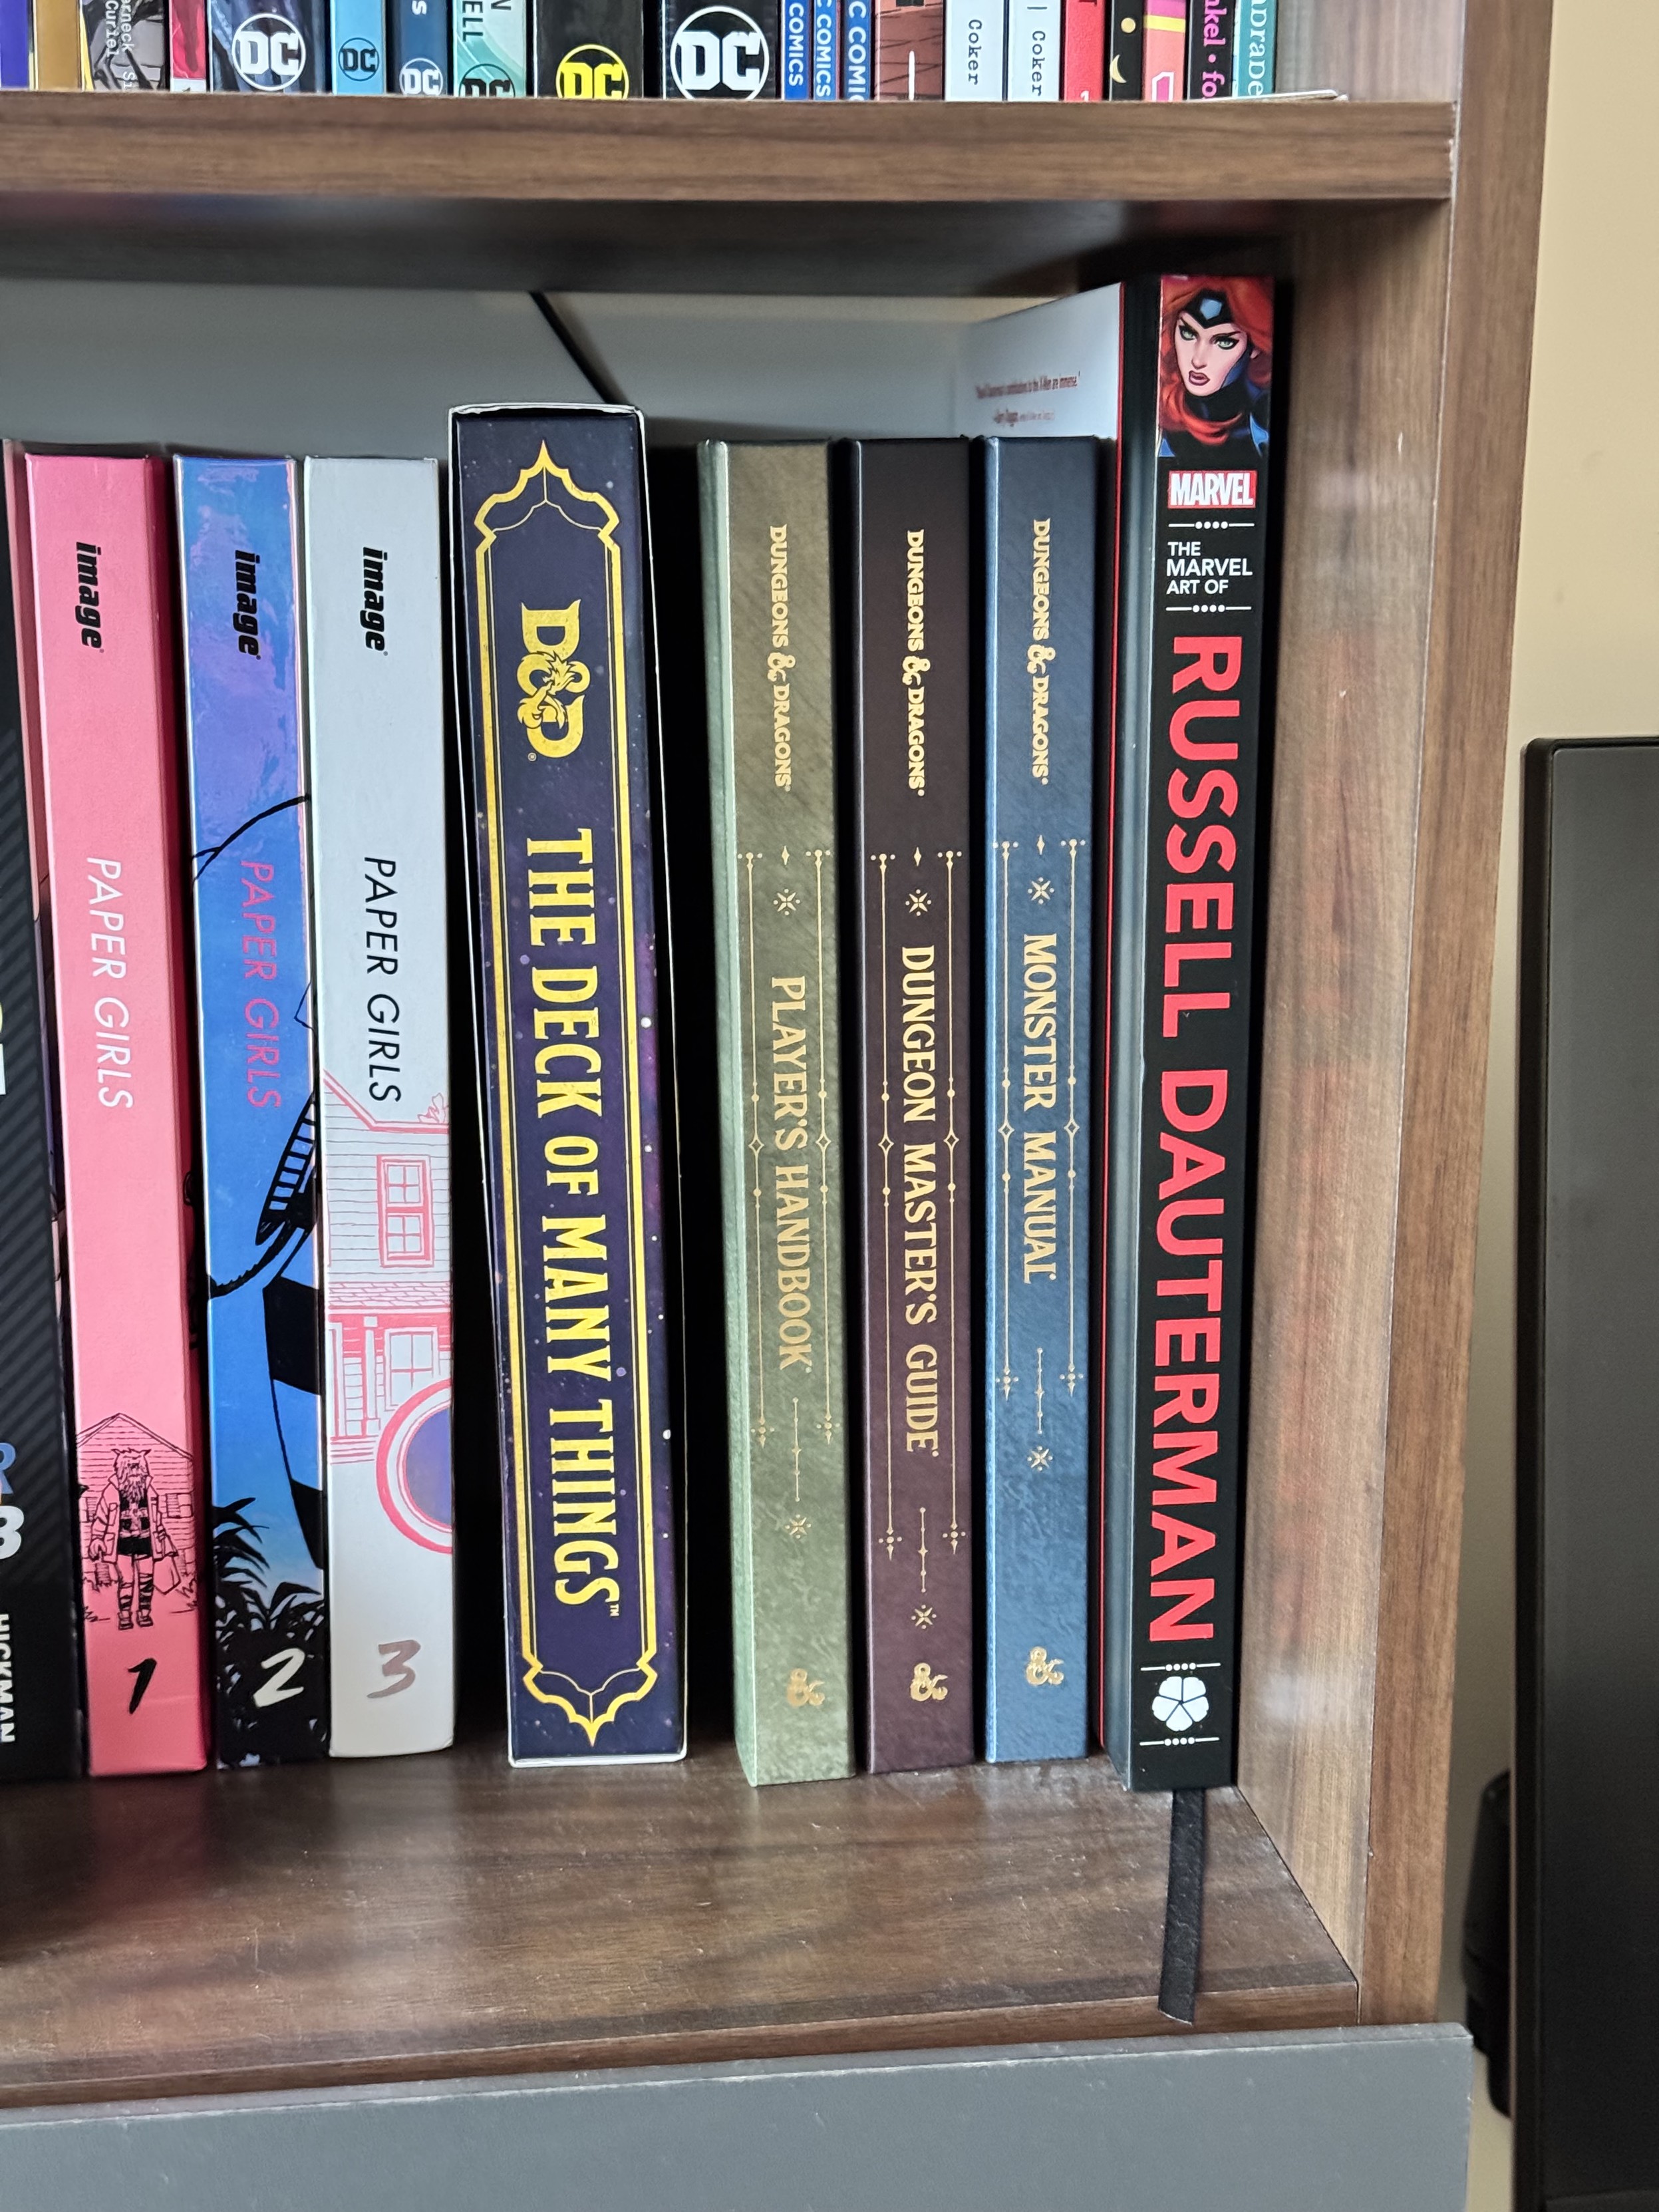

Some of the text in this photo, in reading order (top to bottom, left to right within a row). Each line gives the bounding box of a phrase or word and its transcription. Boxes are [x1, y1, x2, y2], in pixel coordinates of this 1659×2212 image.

[105, 0, 120, 58] Curiel
[235, 31, 299, 76] DC
[340, 48, 377, 72] DC
[676, 31, 760, 90] DC
[788, 3, 804, 86] COMICS
[816, 14, 832, 97] COMICS
[968, 19, 982, 86] Coker
[1031, 30, 1046, 97] Coker
[402, 68, 440, 94] DC
[561, 62, 624, 98] DC
[1169, 472, 1255, 508] MARVEL
[1166, 557, 1253, 577] MARVEL
[1166, 579, 1229, 595] ART OF
[1167, 541, 1201, 557] THE
[75, 541, 102, 649] image
[232, 549, 260, 657] image
[360, 546, 388, 652] image
[767, 524, 796, 789] DUNGEONS & DRAGONS
[902, 529, 931, 792] DUNGEONS & DRAGONS
[1027, 518, 1056, 781] DUNGEONS & DRAGONS
[526, 827, 597, 947] THE
[86, 857, 134, 1109] PAPER GIRLS
[240, 860, 281, 1108] PAPER GIRLS
[364, 856, 402, 1103] PAPER GIRLS
[531, 965, 602, 1119] DECK
[1023, 933, 1057, 1285] MONSTER MANUAL
[1149, 636, 1243, 1643] RUSSELL DAUTERMAN
[543, 1135, 599, 1196] OF
[771, 975, 813, 1371] PLAYER'S HANDBOOK
[901, 945, 939, 1454] DUNGEON MASTER'S GUIDE
[541, 1214, 612, 1382] MANY
[0, 1613, 16, 1744] HICKMAN
[128, 1657, 158, 1715] 1
[253, 1647, 305, 1708] 2
[366, 1639, 421, 1699] 3
